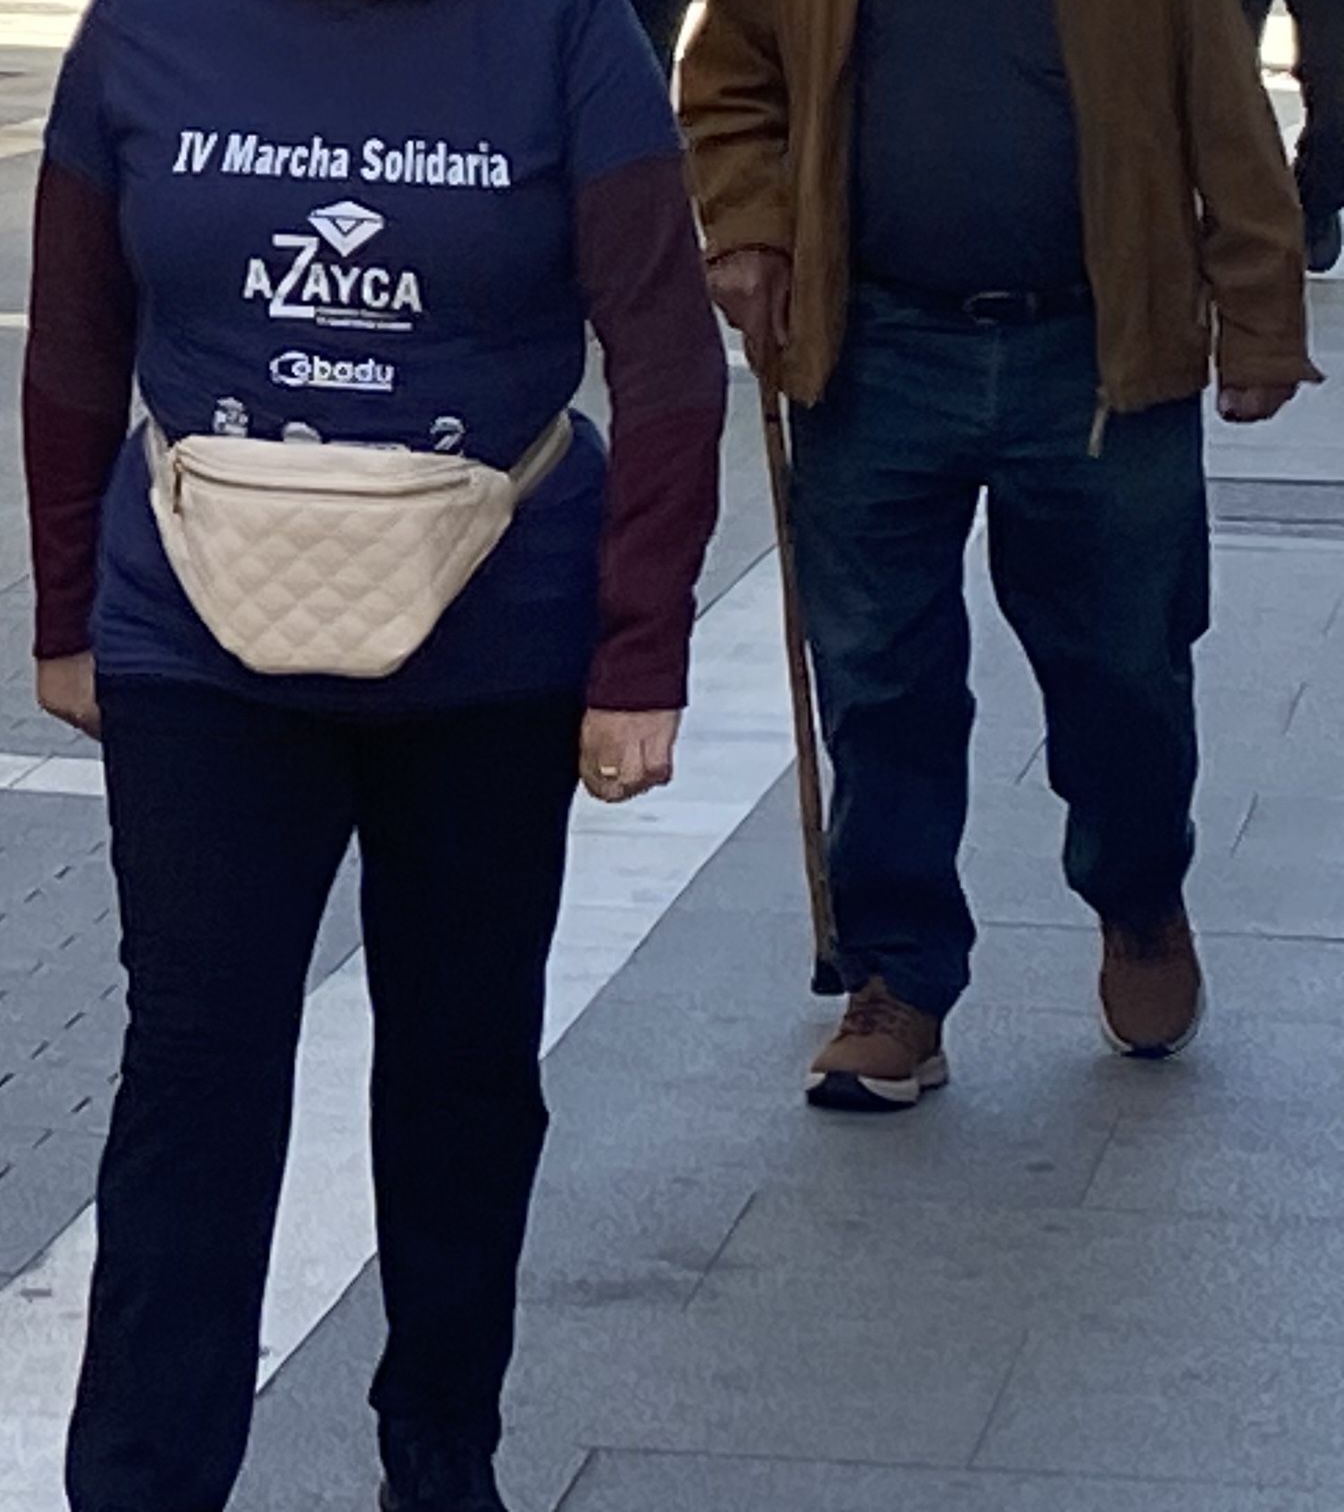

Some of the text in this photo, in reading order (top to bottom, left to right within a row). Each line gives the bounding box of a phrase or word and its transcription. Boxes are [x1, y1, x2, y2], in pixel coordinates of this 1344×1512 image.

[172, 131, 511, 188] IV Marcha Solidaria
[243, 234, 423, 319] AZAYCA
